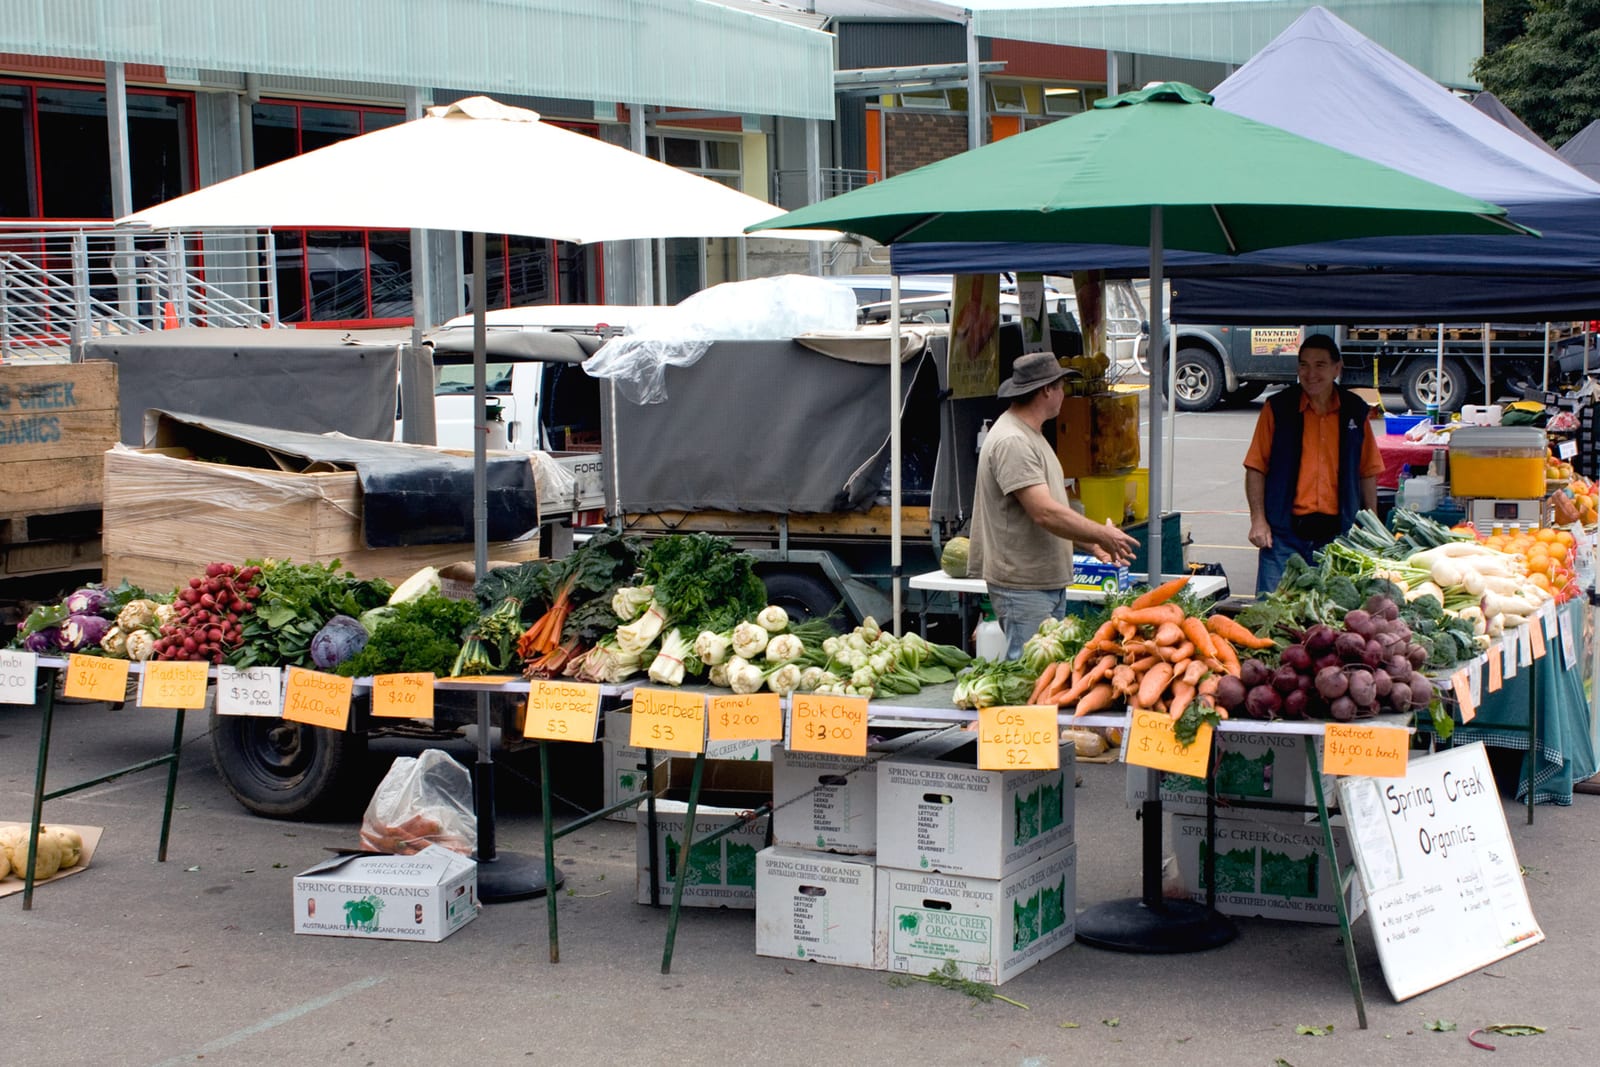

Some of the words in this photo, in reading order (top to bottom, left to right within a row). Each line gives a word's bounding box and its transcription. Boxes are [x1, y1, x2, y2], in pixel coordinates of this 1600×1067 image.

[574, 462, 603, 474] FORD
[151, 665, 206, 681] Radishes
[221, 667, 272, 683] Spinach
[77, 671, 98, 693] $4
[292, 671, 347, 699] Cabbage
[538, 682, 586, 697] Rainbow
[533, 699, 594, 714] Silverbeet
[634, 692, 703, 722] Silverbeet
[713, 697, 752, 709] Fennel
[798, 702, 826, 718] Buk
[831, 705, 862, 727] Choy
[996, 709, 1025, 726] Cos
[546, 719, 569, 735] $3
[651, 724, 676, 741] $3
[1327, 725, 1375, 740] Beetroot
[981, 729, 1052, 745] Lettuce
[1229, 731, 1297, 748] ORGANICS
[784, 751, 813, 761] SPRING
[1006, 749, 1032, 765] $2
[888, 768, 918, 777] SPRING
[919, 770, 945, 780] CREEK
[947, 773, 991, 784] ORGANICS
[1386, 784, 1436, 822] Spring
[1443, 765, 1486, 802] Creek
[1182, 826, 1227, 839] SPRNG
[1231, 829, 1271, 842] CREEK
[1273, 834, 1341, 848] ORGANIS
[1419, 824, 1476, 859] Organics
[765, 860, 794, 870] SPRING
[795, 863, 820, 873] CREEK
[820, 866, 862, 877] ORGANICS
[297, 882, 336, 893] SPRING
[338, 884, 372, 896] CREEK
[373, 886, 430, 898] ORGANICS
[921, 877, 967, 889] AUSTRALIAN
[1005, 878, 1027, 899] SPRING
[895, 882, 928, 894] CERTIFIED
[929, 886, 960, 898] ORGANIC
[962, 890, 993, 901] PRODUCE
[302, 922, 339, 931] AUSTRALIAN
[396, 927, 426, 936] PRODUCE
[926, 912, 957, 926] SPRING
[959, 916, 987, 930] CREEK
[925, 924, 988, 941] ORGANICS
